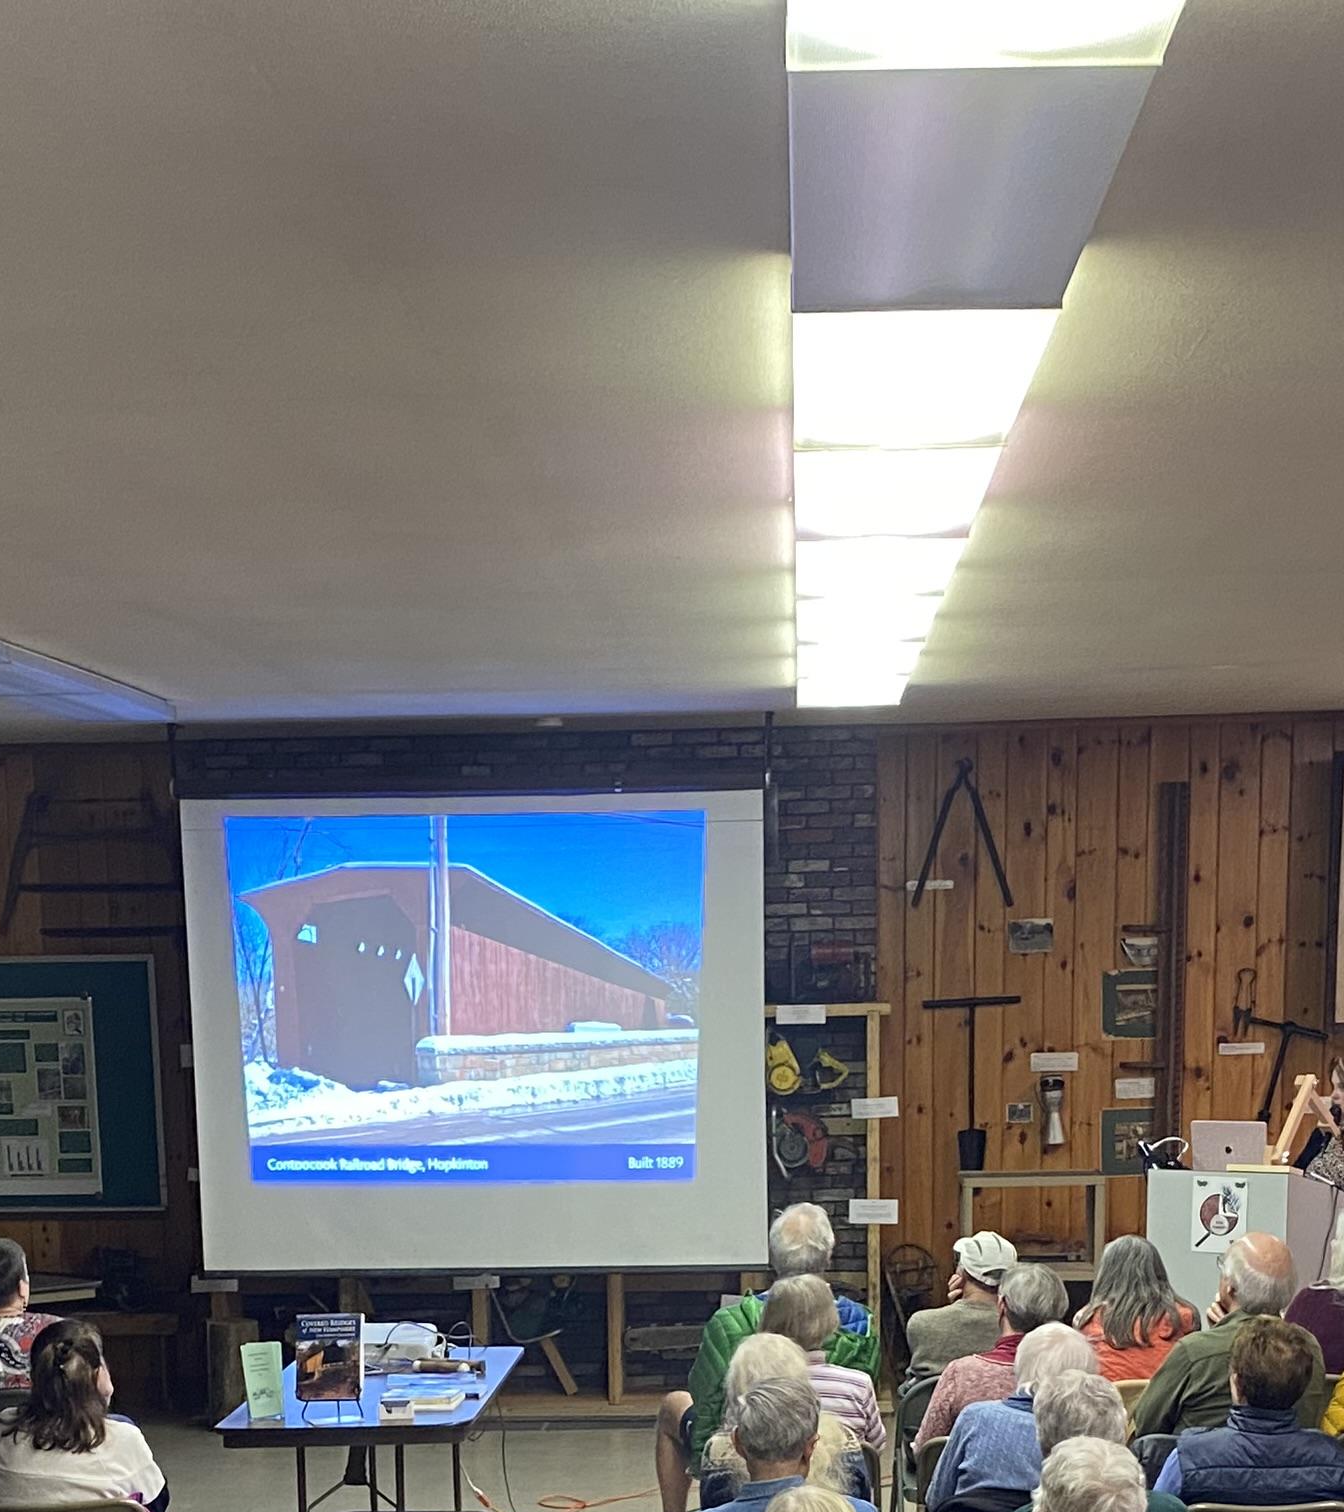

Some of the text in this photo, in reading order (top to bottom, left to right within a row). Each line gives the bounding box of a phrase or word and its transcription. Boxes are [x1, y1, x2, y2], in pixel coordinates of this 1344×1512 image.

[267, 1156, 489, 1174] Contoocook Railroad Bridge, Hopkinton
[628, 1156, 684, 1169] Built 1889
